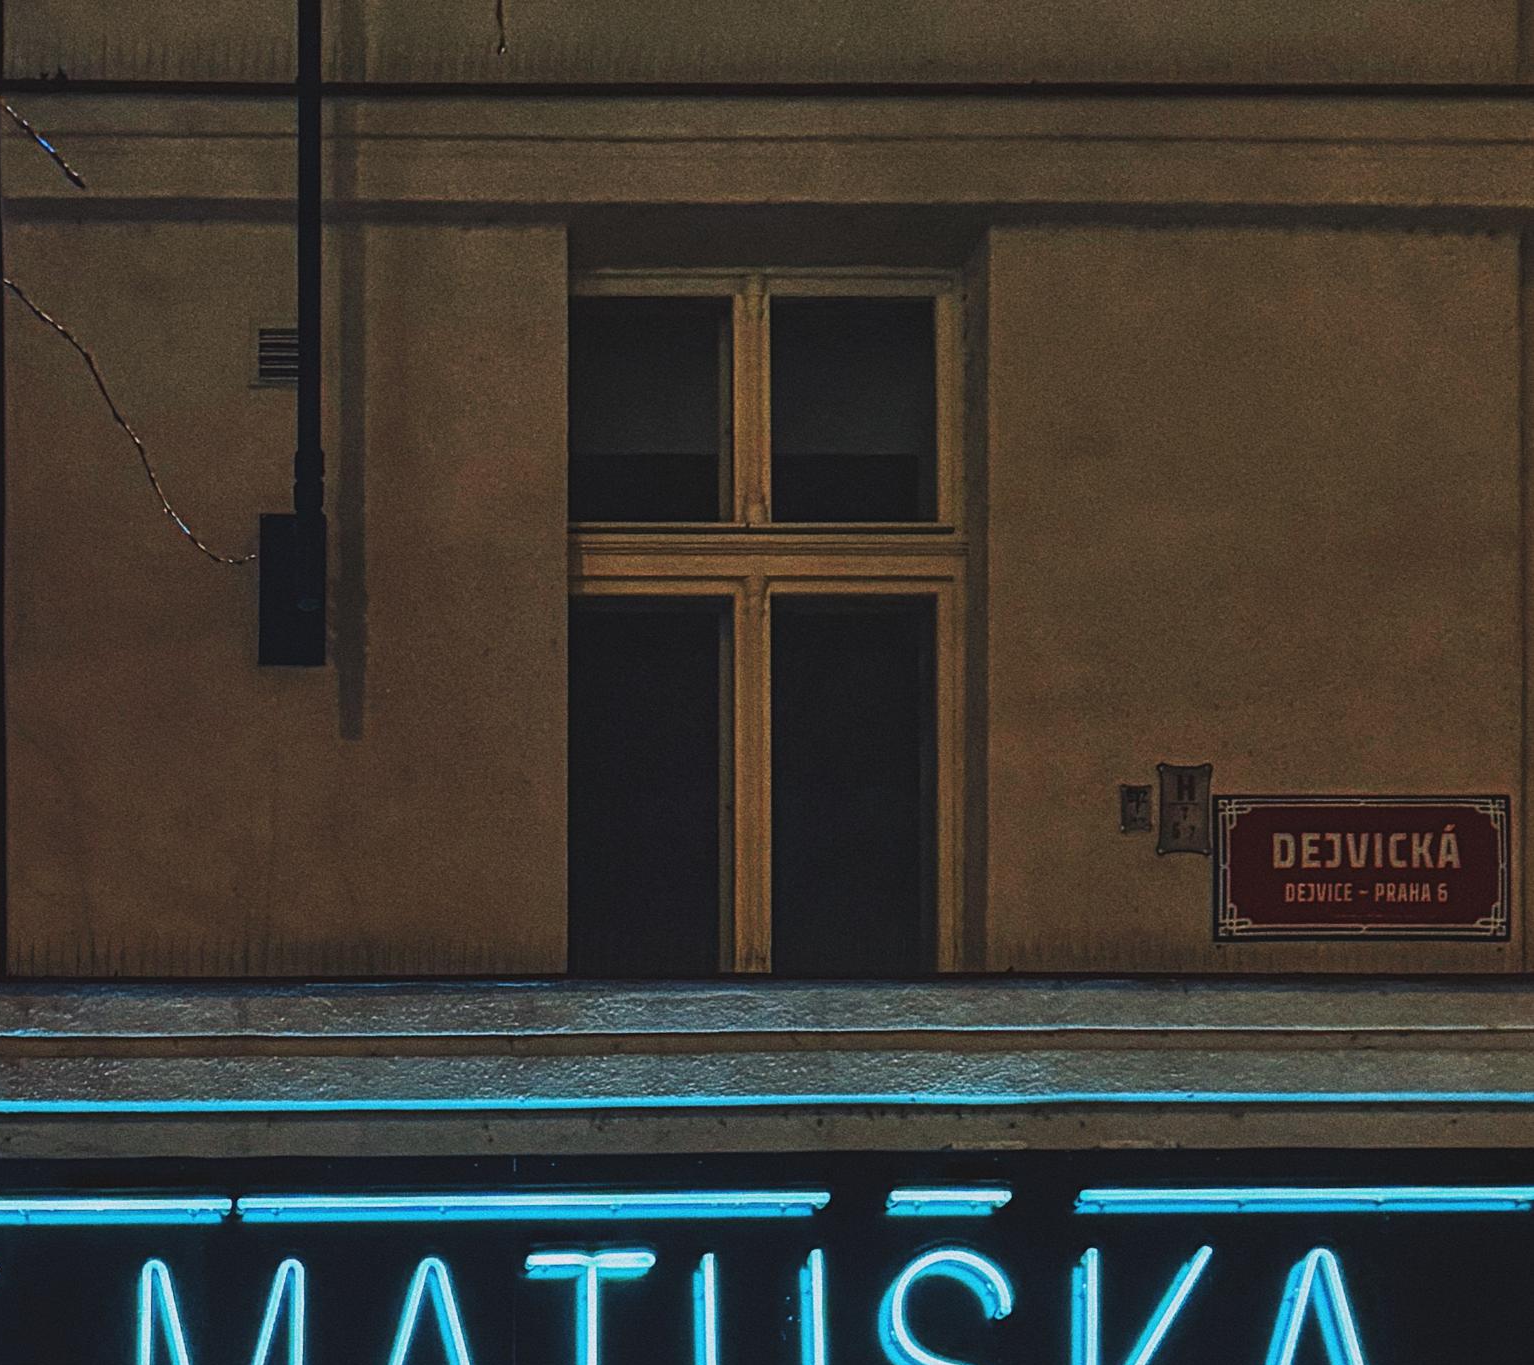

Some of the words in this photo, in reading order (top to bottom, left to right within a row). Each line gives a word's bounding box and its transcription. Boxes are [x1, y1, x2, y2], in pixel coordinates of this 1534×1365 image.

[1272, 825, 1461, 869] DEJVICKÁ
[1284, 882, 1353, 902] DEJVICE
[1375, 882, 1432, 902] PRAHA
[1437, 882, 1449, 902] 6
